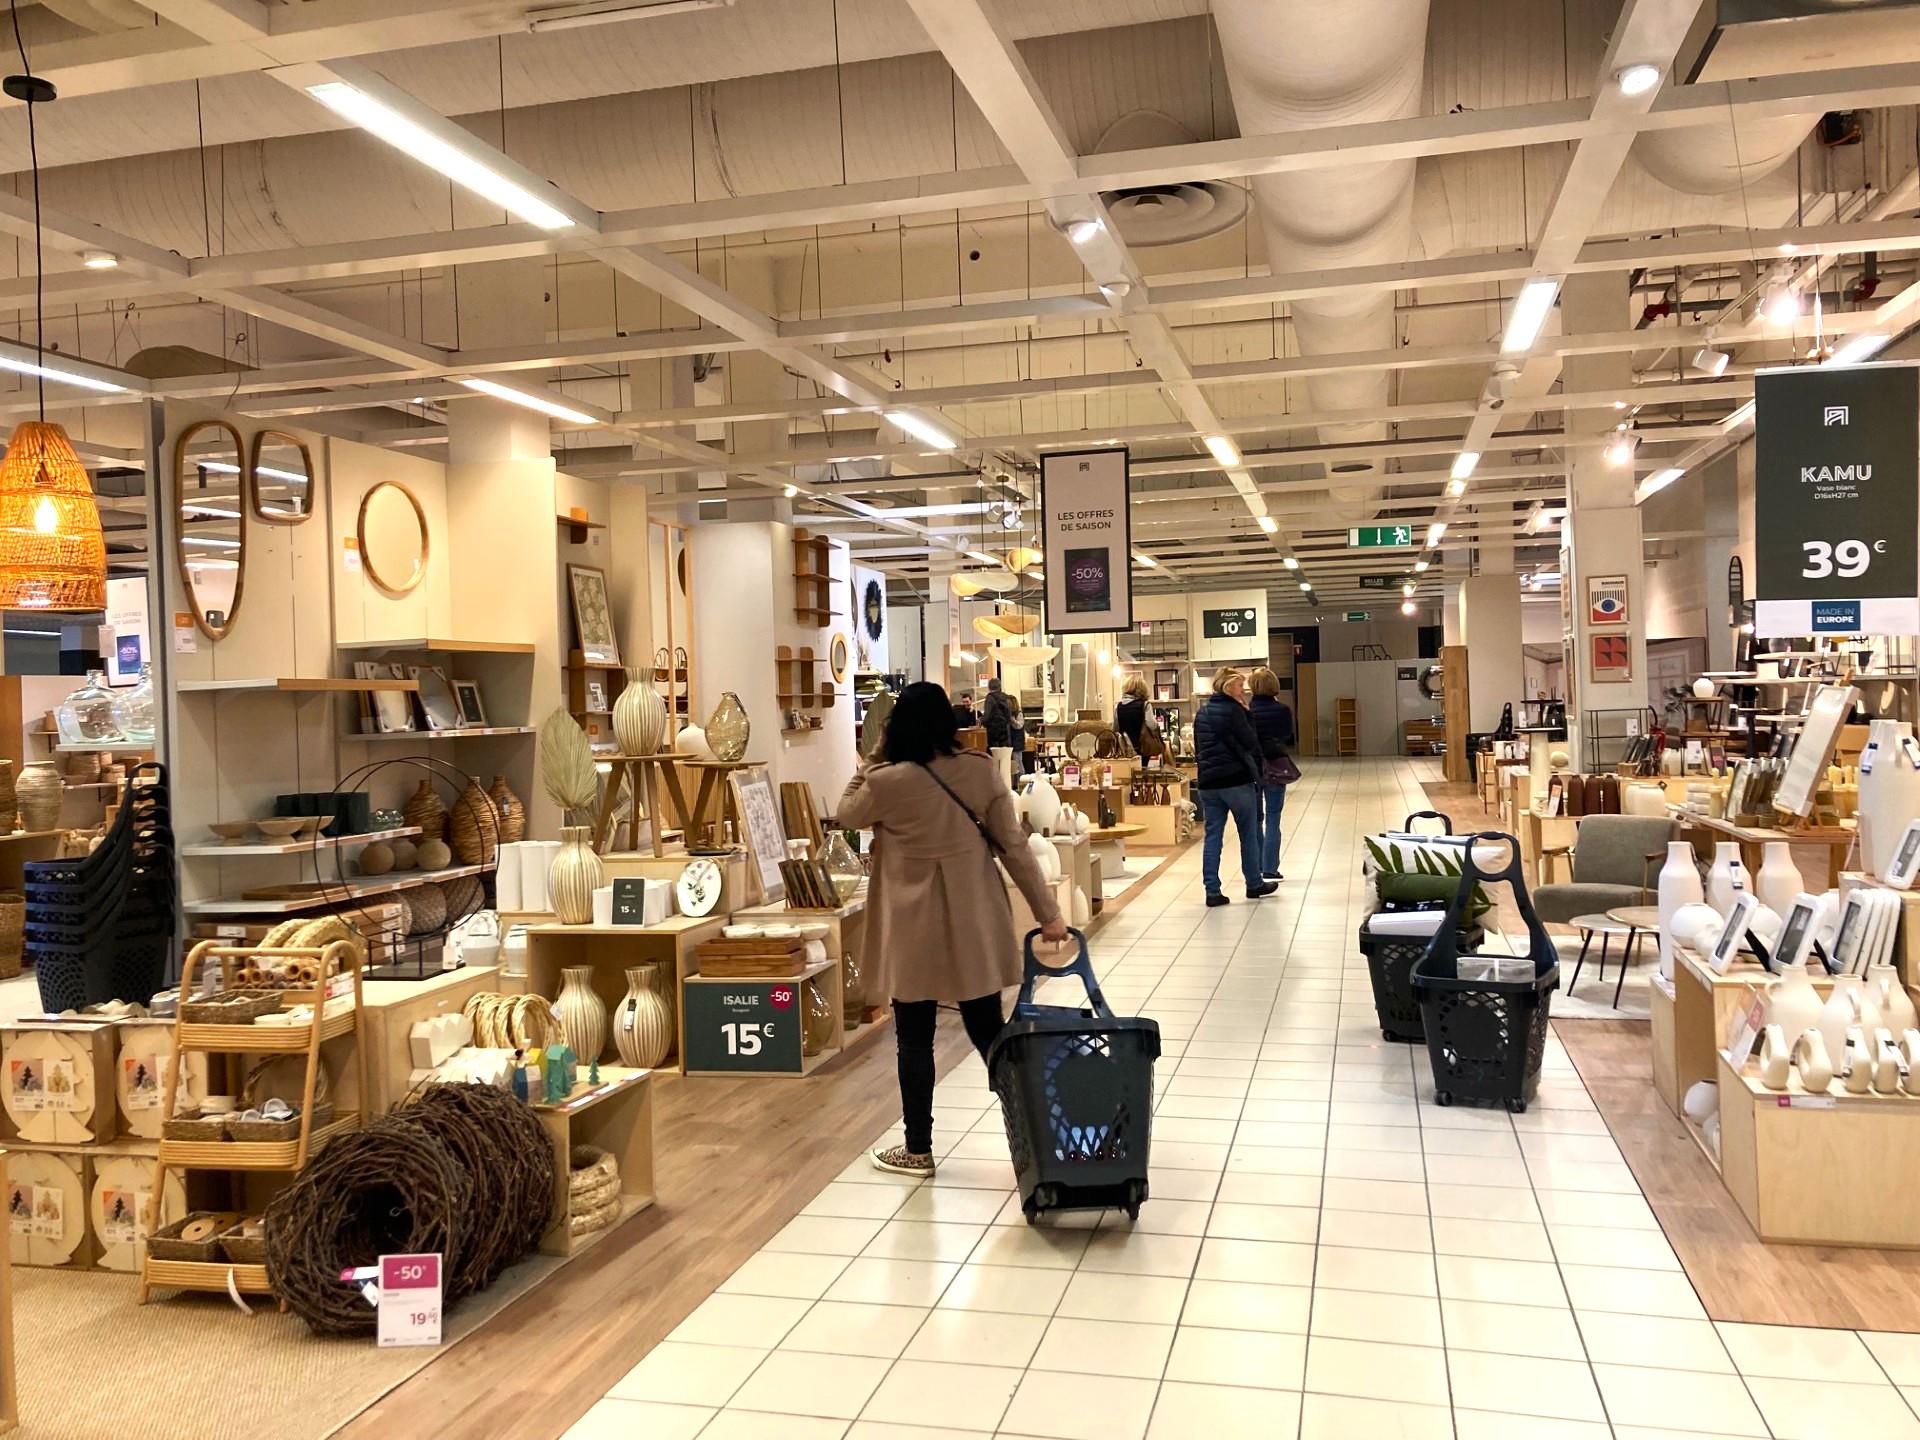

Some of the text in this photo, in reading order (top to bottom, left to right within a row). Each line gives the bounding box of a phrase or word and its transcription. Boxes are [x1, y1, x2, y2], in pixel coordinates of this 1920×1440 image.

[1801, 464, 1872, 483] KAMU
[1057, 509, 1114, 521] LES OFFRES
[1060, 521, 1111, 532] DE SAISON
[1071, 567, 1103, 580] -50%
[1816, 607, 1855, 615] MADE IN
[620, 905, 630, 913] 15
[723, 995, 759, 1005] ISALIE
